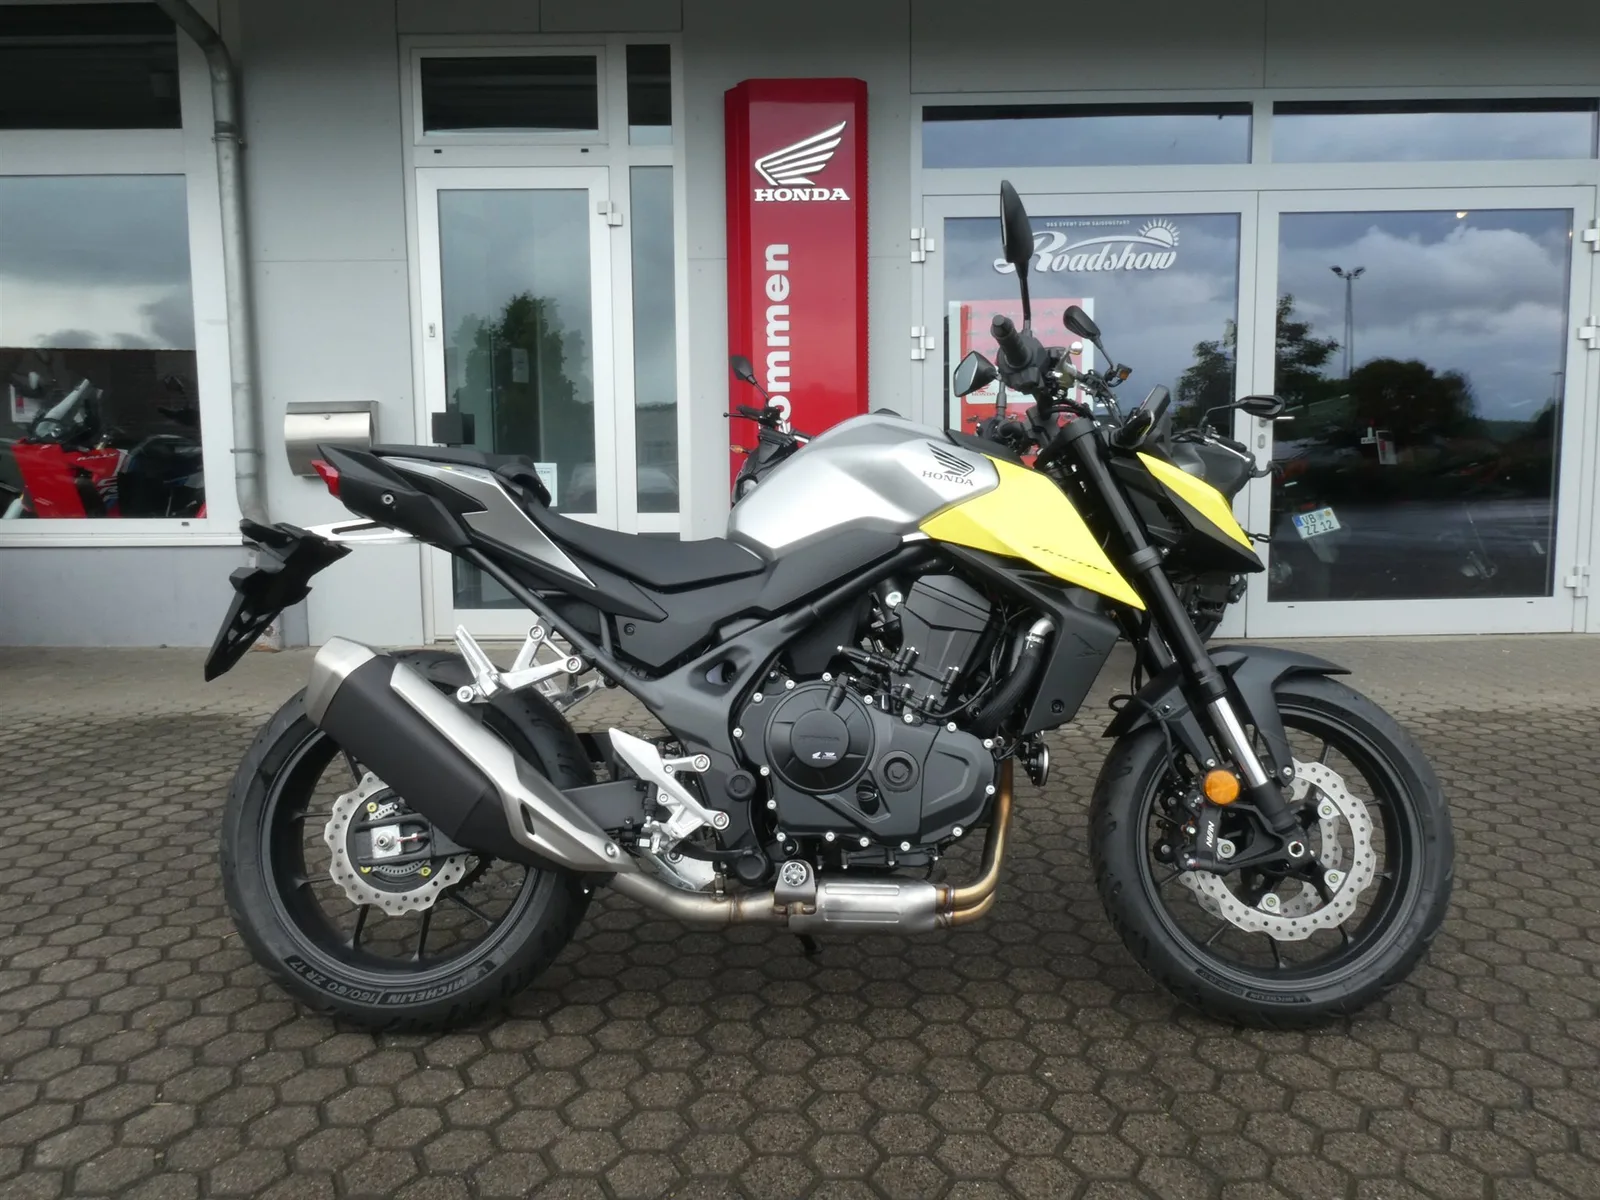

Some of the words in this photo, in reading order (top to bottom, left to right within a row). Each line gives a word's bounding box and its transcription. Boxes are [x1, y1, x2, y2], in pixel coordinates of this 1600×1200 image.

[754, 188, 850, 202] HONDA
[993, 230, 1177, 274] Roadshow
[763, 244, 791, 434] ommen
[922, 470, 974, 486] HONDA
[1302, 513, 1317, 525] VB
[1304, 523, 1320, 536] ZZ
[1320, 519, 1335, 532] 12
[326, 982, 376, 1003] 160/60
[387, 976, 468, 1004] MICHELIN
